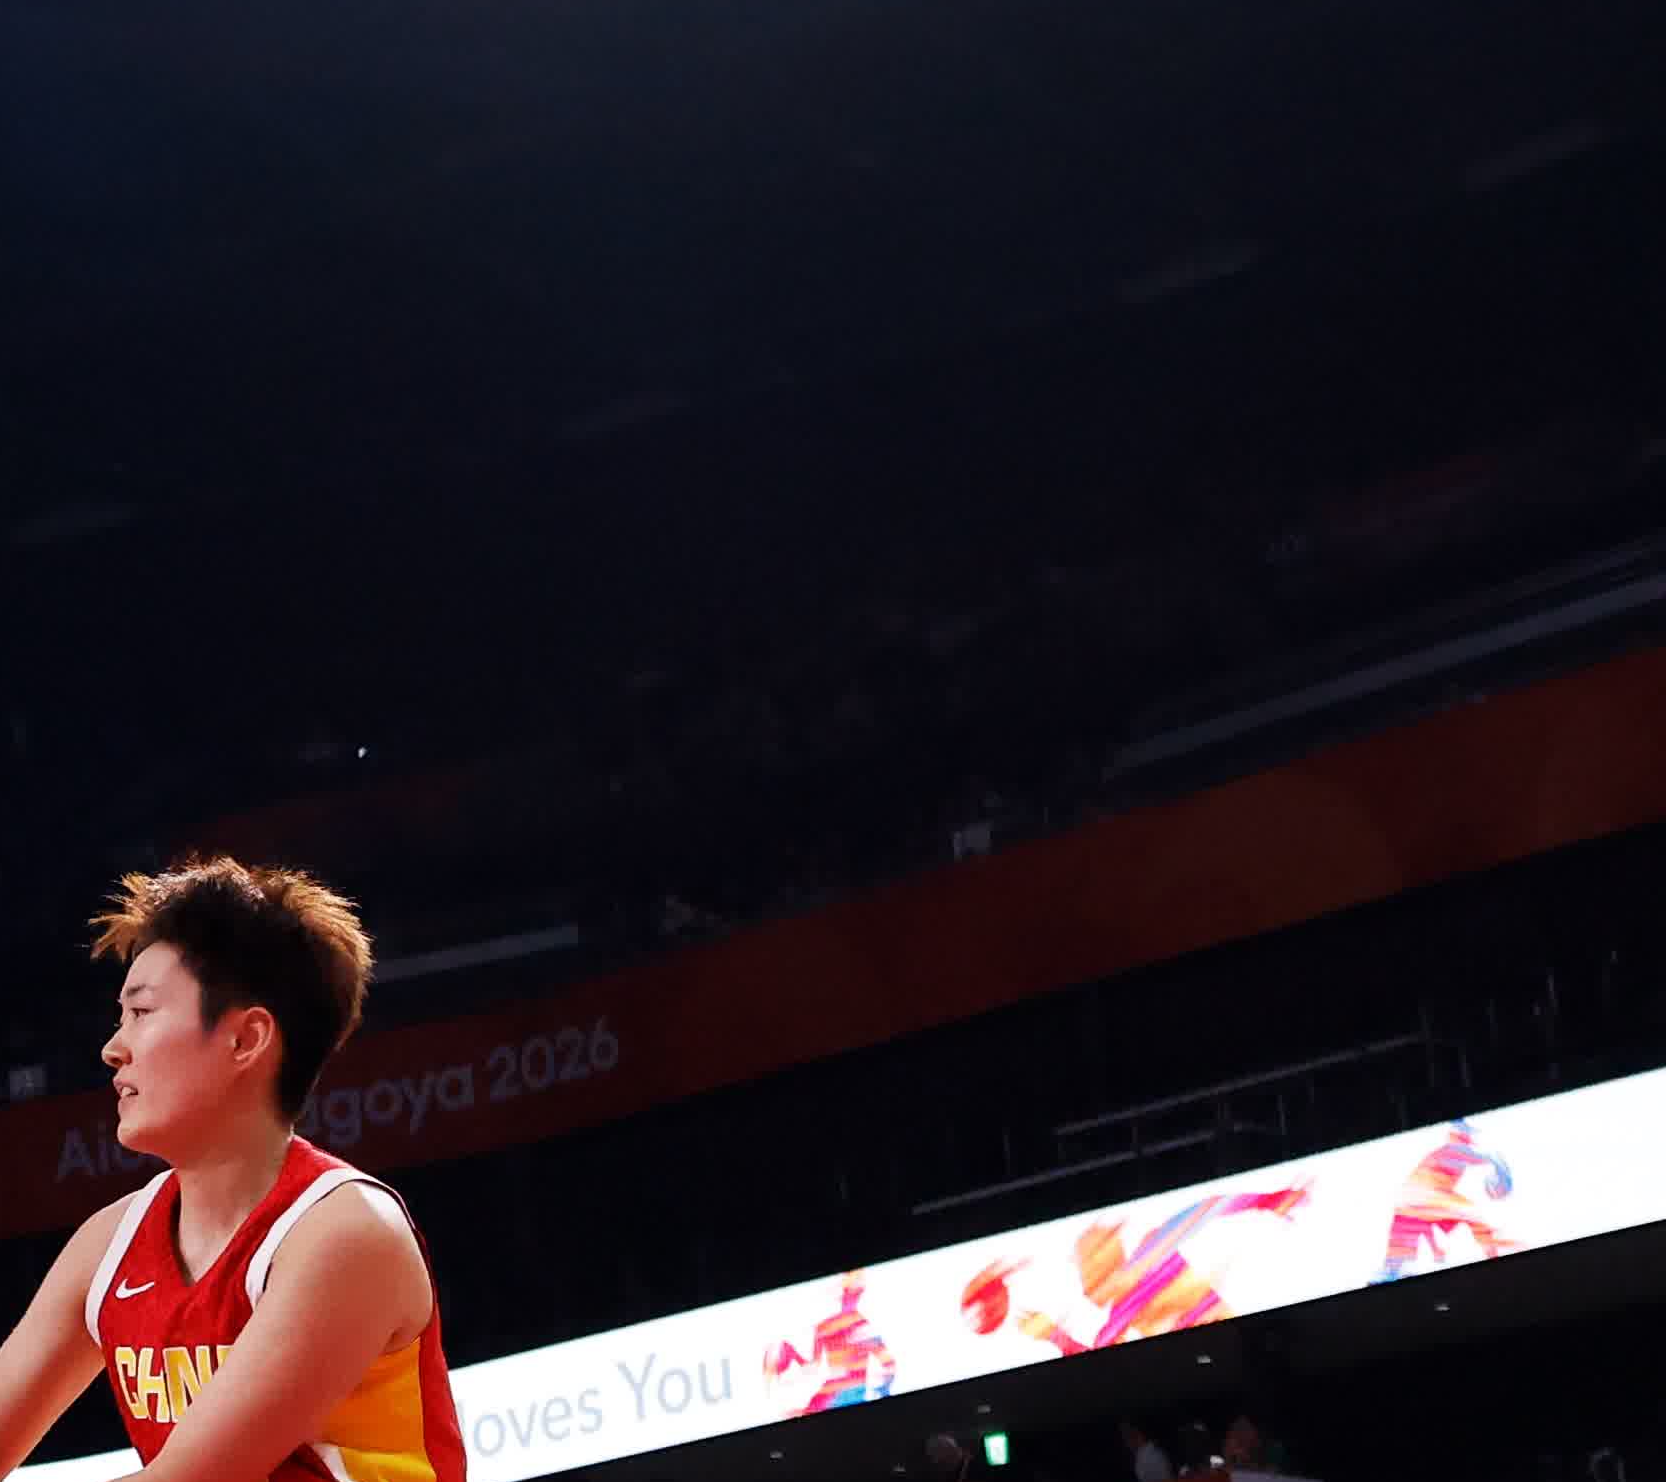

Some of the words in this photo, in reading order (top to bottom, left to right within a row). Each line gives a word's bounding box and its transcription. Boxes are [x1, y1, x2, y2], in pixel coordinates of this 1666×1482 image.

[488, 1017, 620, 1106] 2026
[457, 1377, 606, 1459] oves
[616, 1349, 734, 1421] You
